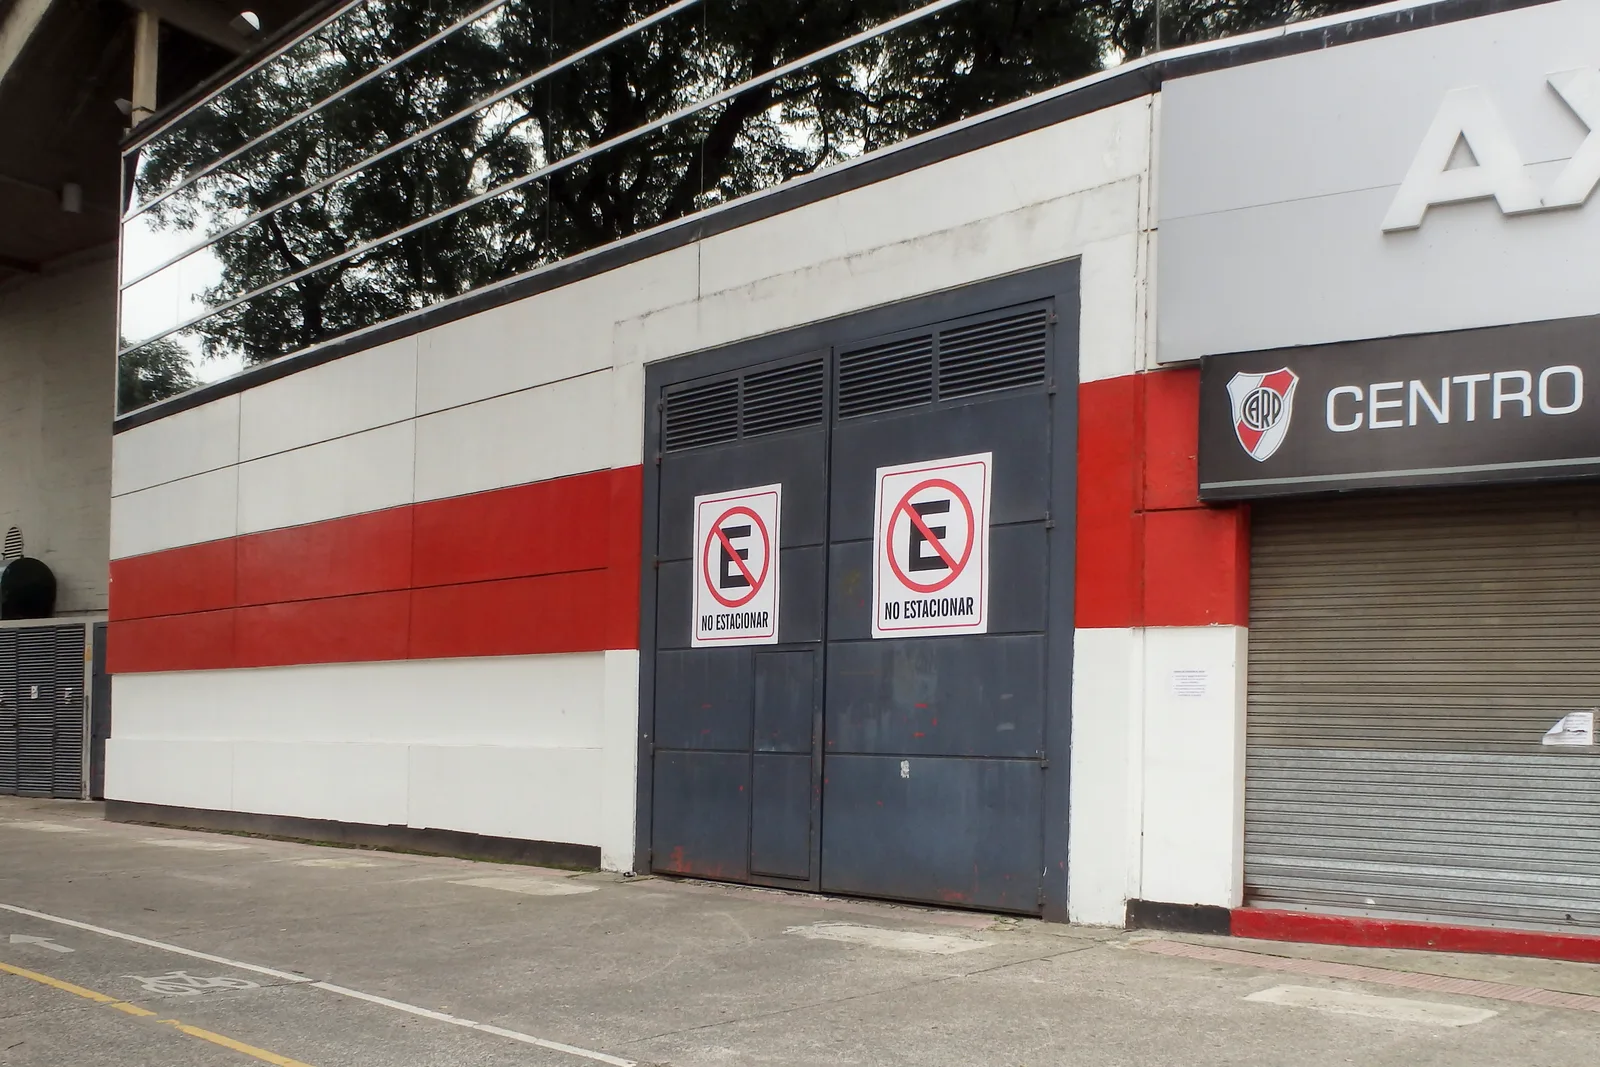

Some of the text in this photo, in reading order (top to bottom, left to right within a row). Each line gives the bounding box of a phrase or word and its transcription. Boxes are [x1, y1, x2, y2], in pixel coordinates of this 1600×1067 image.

[1326, 364, 1584, 433] CENTRO
[720, 525, 751, 589] E
[909, 499, 950, 572] E
[701, 611, 769, 632] NO ESTACIONAR
[884, 597, 974, 620] NO ESTACIONAR
